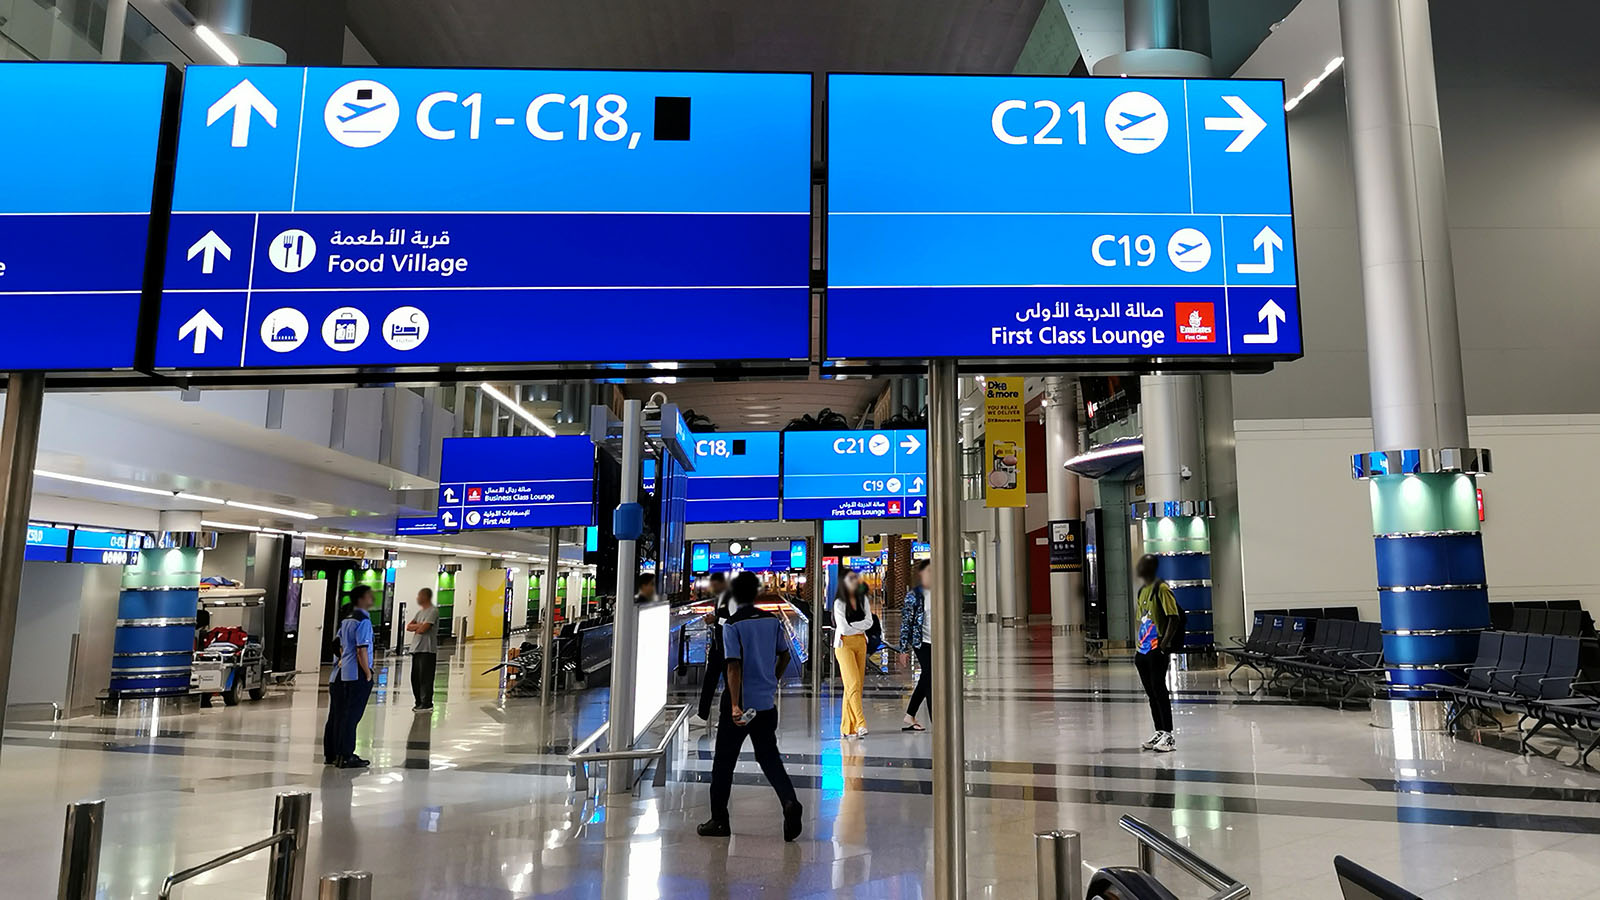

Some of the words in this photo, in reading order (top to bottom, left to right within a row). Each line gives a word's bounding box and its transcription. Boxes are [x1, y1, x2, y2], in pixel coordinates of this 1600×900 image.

[991, 99, 1087, 145] C21
[330, 228, 406, 246] الأطعمة
[410, 230, 451, 249] قرية
[1091, 234, 1156, 267] C19
[327, 253, 385, 273] Food
[391, 253, 468, 277] Village
[1015, 301, 1070, 323] الأولى
[1074, 302, 1121, 322] الدرجة
[1125, 302, 1164, 319] صالة
[991, 327, 1033, 345] First
[1038, 326, 1087, 345] Class
[1092, 326, 1165, 349] Lounge
[987, 390, 995, 398] &
[695, 440, 731, 458] C18,
[833, 438, 865, 454] C21
[862, 480, 884, 492] C19
[530, 493, 555, 502] Lounge
[846, 508, 862, 516] Class
[482, 518, 498, 526] First
[498, 517, 511, 525] Aid
